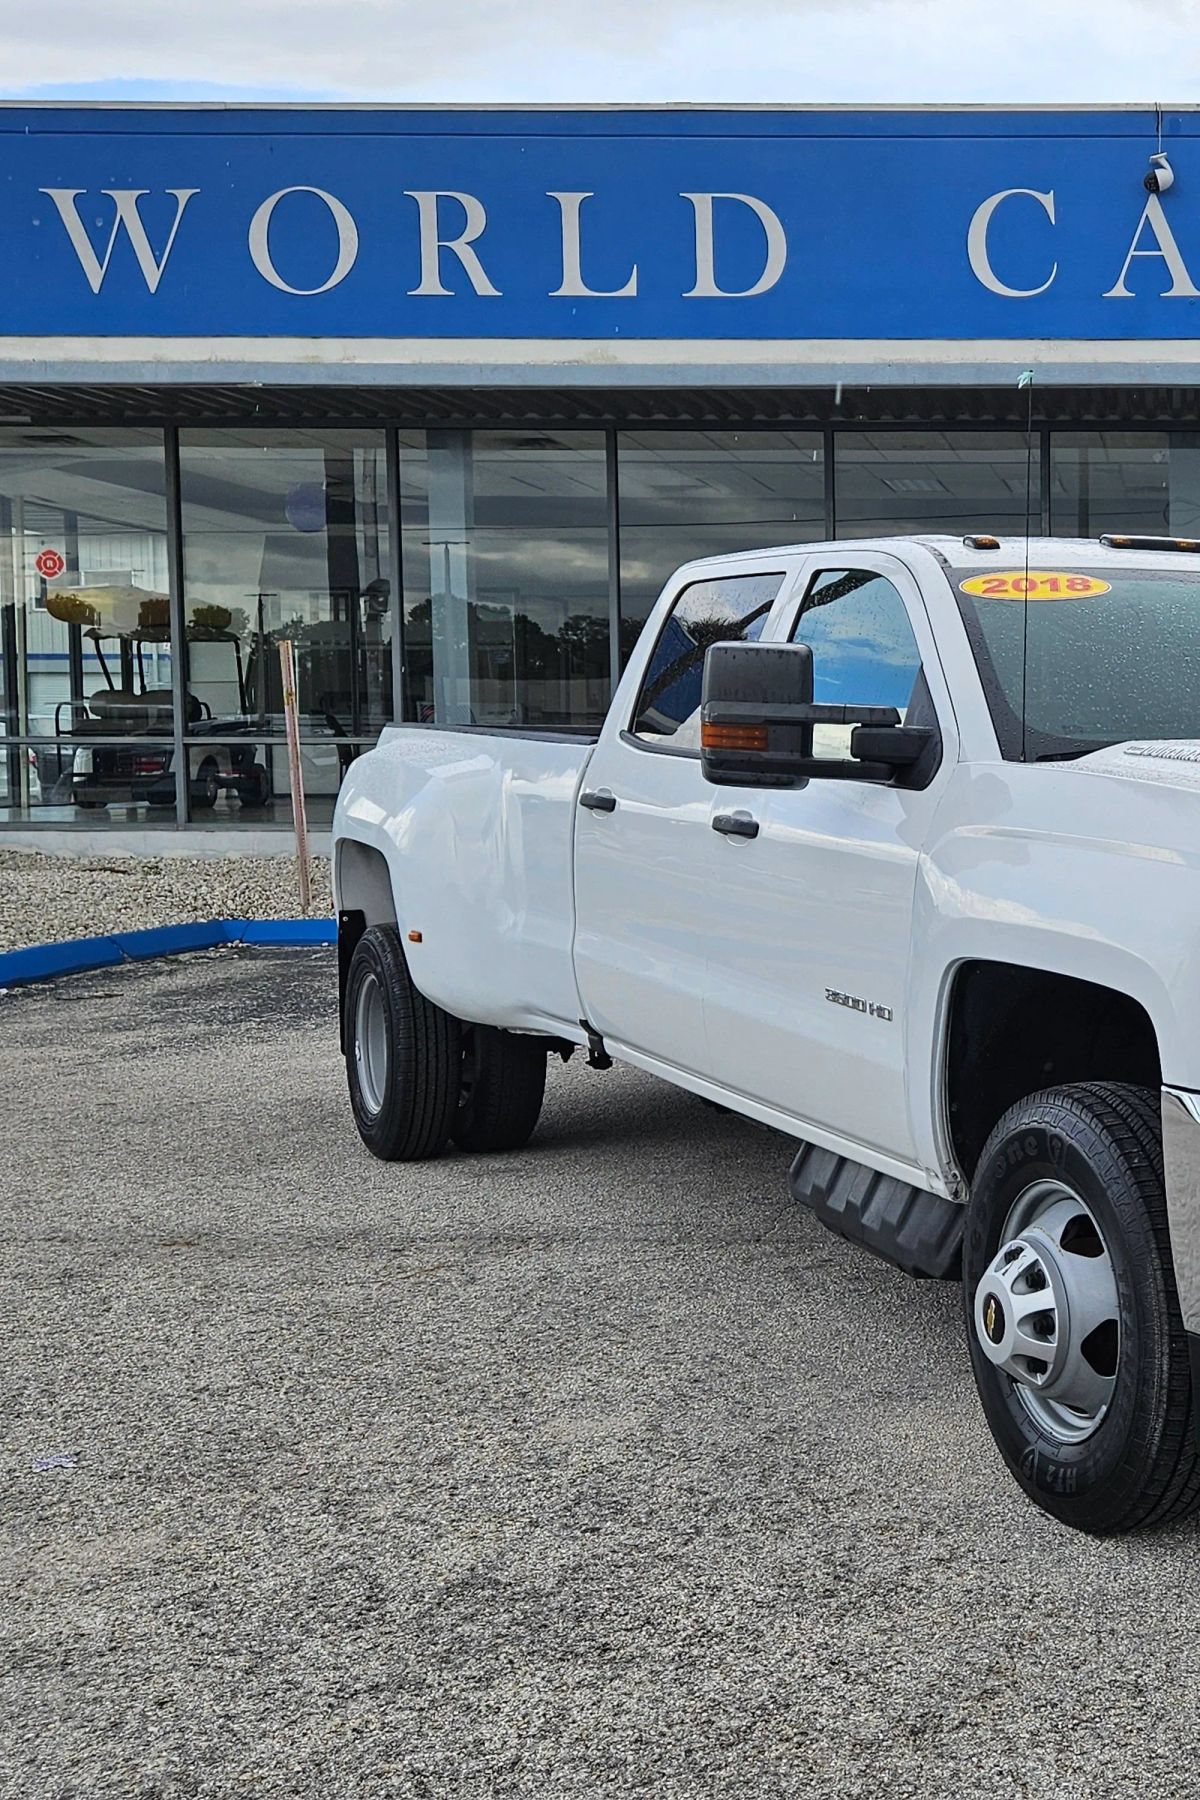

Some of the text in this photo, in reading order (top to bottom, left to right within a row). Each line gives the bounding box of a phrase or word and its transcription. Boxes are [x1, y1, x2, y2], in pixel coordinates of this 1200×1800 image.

[39, 187, 787, 297] WORLD
[981, 577, 1092, 594] 2018
[824, 987, 893, 1022] 3500 HD
